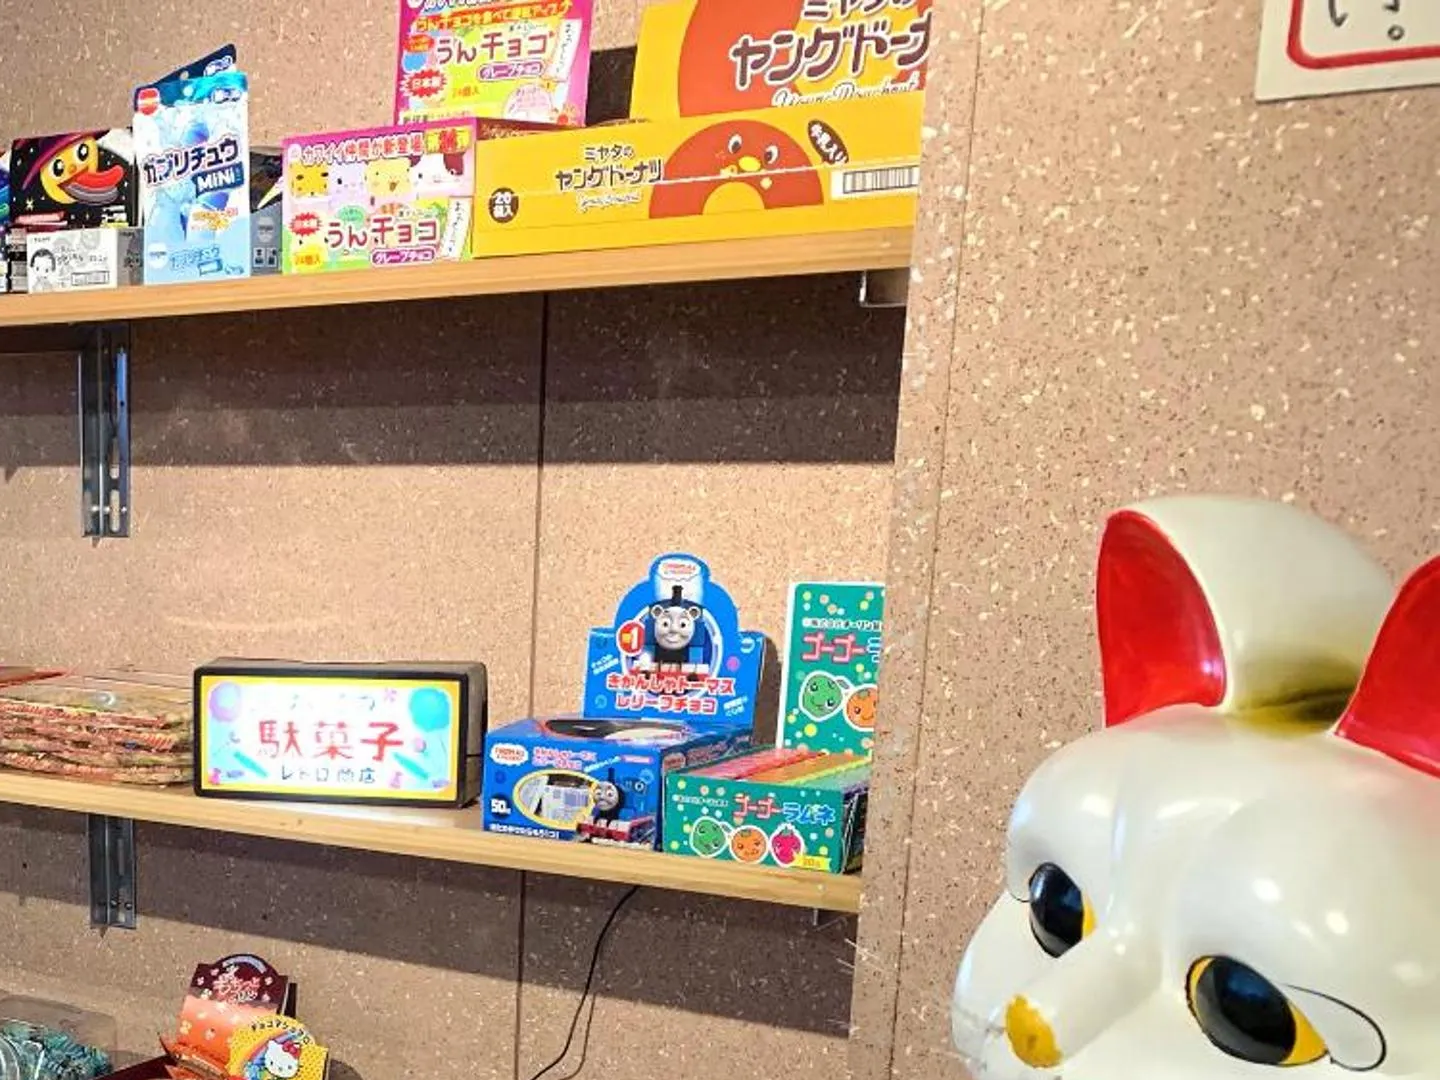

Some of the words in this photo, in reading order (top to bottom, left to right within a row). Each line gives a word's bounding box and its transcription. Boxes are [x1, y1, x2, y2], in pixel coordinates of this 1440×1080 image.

[437, 31, 548, 66] うんチョコ
[143, 137, 240, 185] ガブリチュウ
[583, 143, 635, 161] ミヤタの
[196, 169, 236, 191] MINI
[555, 158, 663, 191] ヤングドーナツ
[327, 217, 437, 248] うんチョコ
[607, 672, 735, 694] きかんしゃトーマス
[258, 719, 405, 762] 駄菓子
[733, 792, 837, 826] ゴーゴーラムネ
